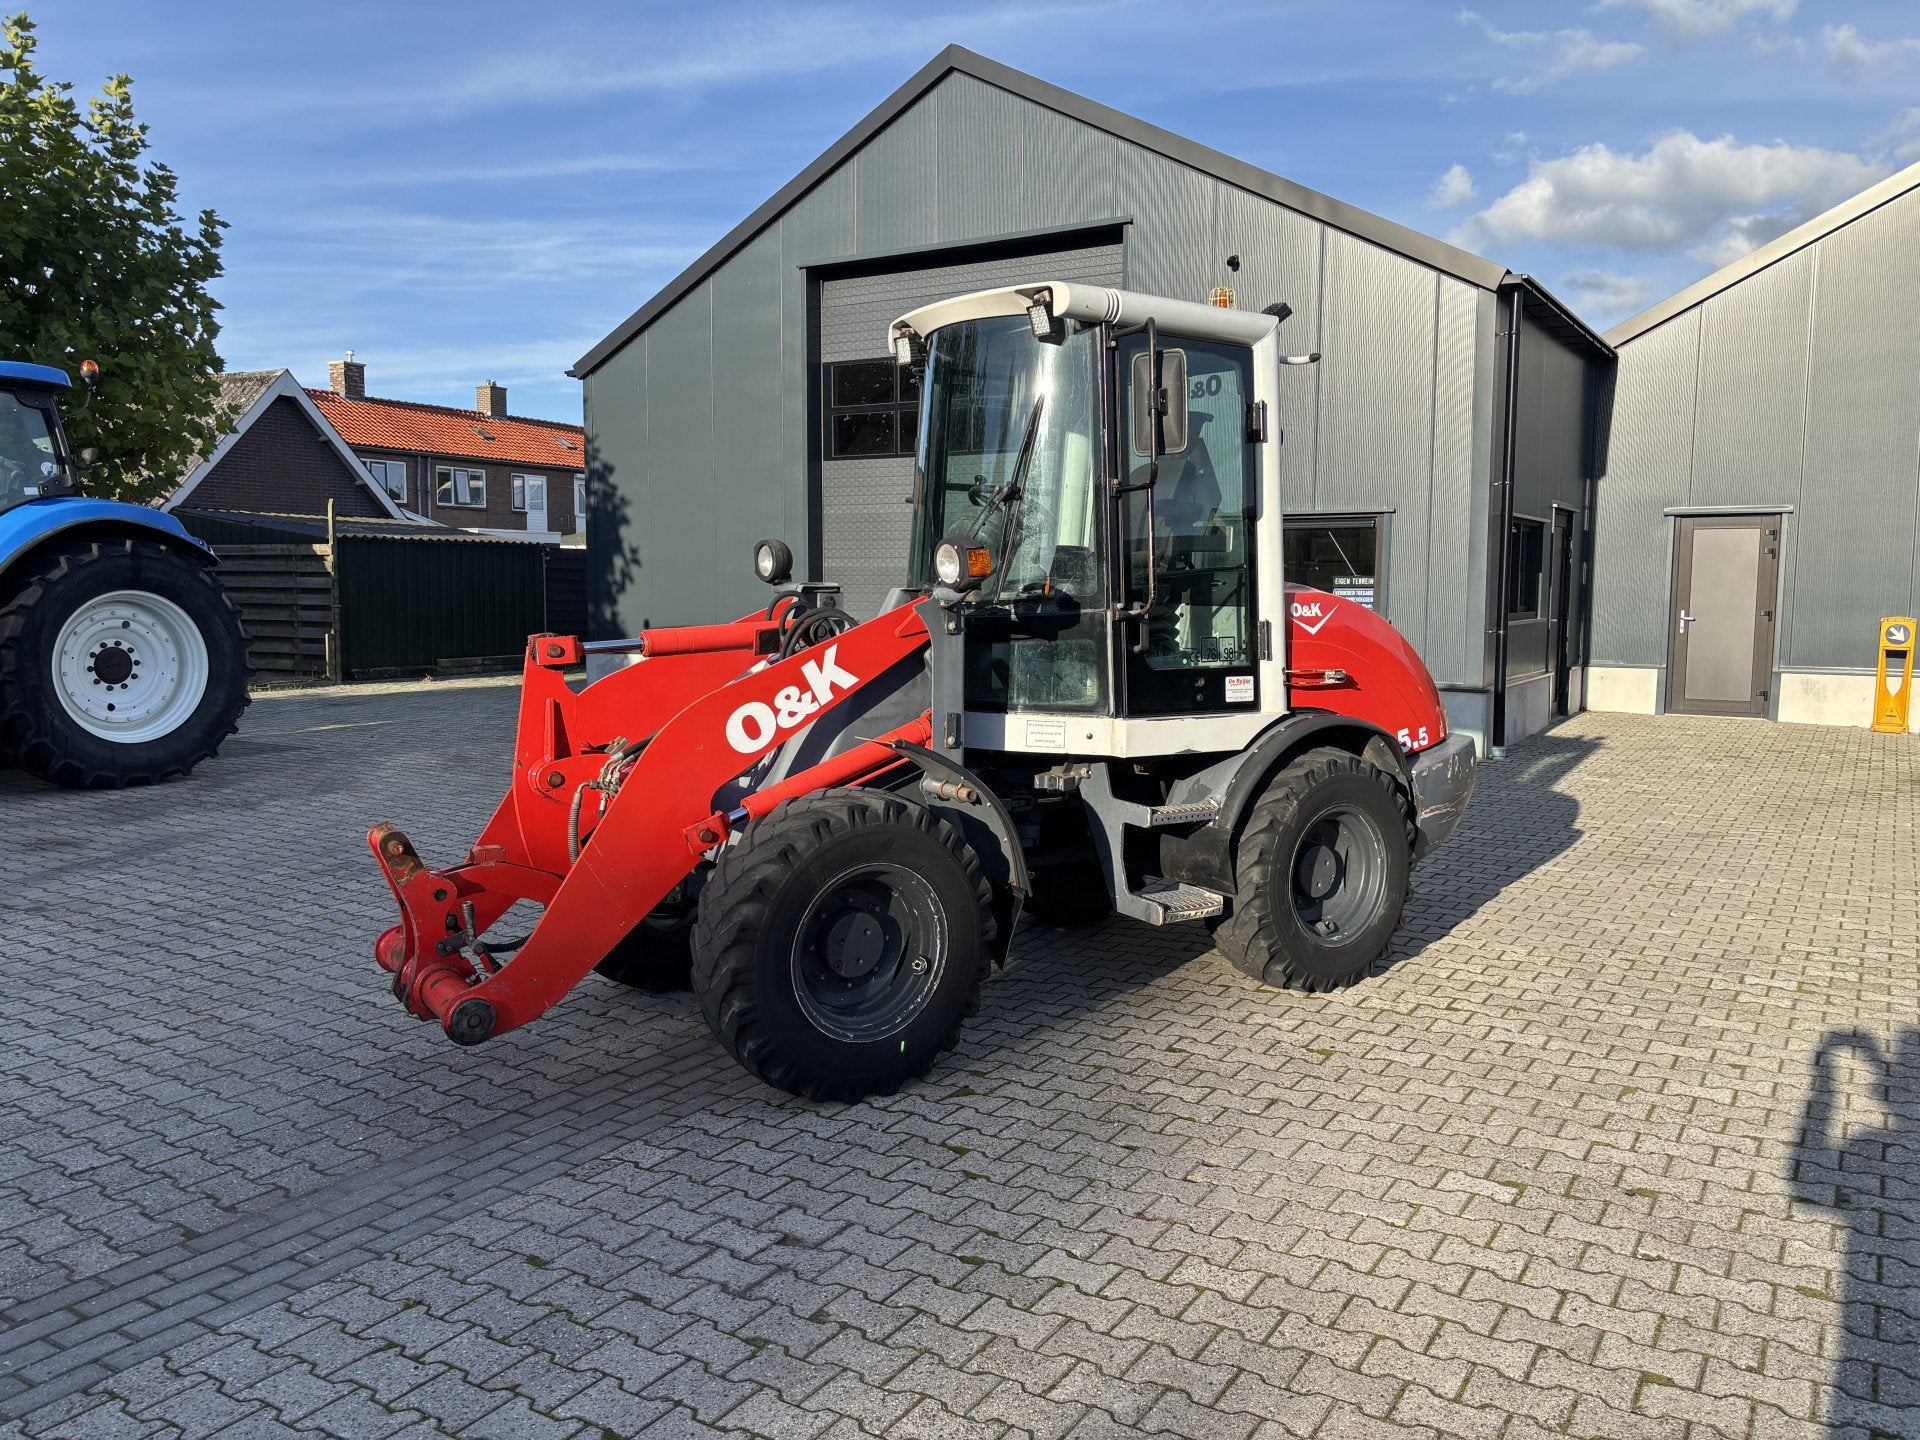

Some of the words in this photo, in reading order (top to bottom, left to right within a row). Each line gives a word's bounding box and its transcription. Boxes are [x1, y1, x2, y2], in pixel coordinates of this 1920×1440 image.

[1335, 577, 1350, 585] EIGEN
[1352, 577, 1374, 585] TERREIN
[1291, 602, 1322, 617] O&K
[1223, 647, 1233, 660] 98
[725, 643, 860, 754] O&K
[1397, 726, 1429, 753] 5.5
